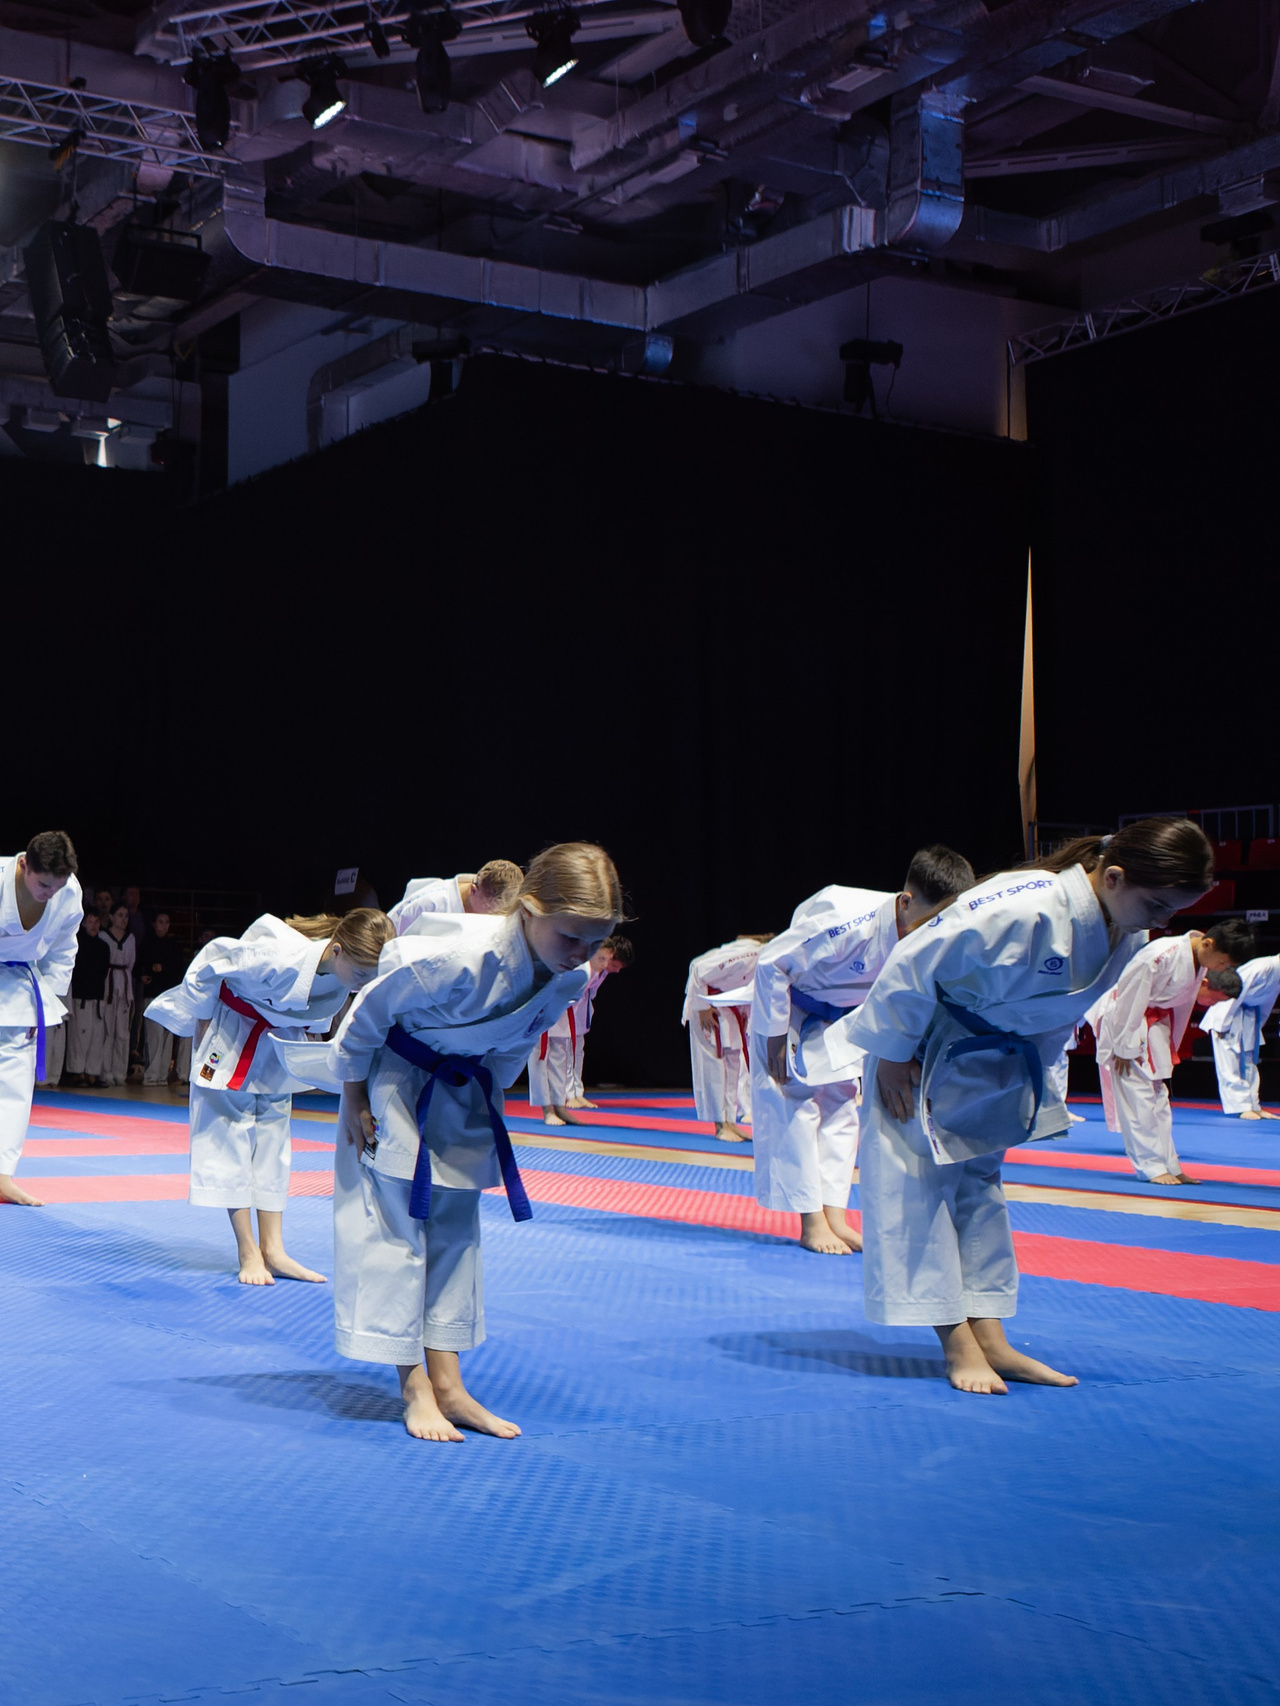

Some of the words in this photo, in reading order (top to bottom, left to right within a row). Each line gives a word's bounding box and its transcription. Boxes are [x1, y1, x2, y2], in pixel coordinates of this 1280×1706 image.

[968, 891, 1004, 911] BEST
[1006, 880, 1053, 896] SPORT
[828, 921, 852, 939] BEST
[853, 910, 878, 927] SPOR
